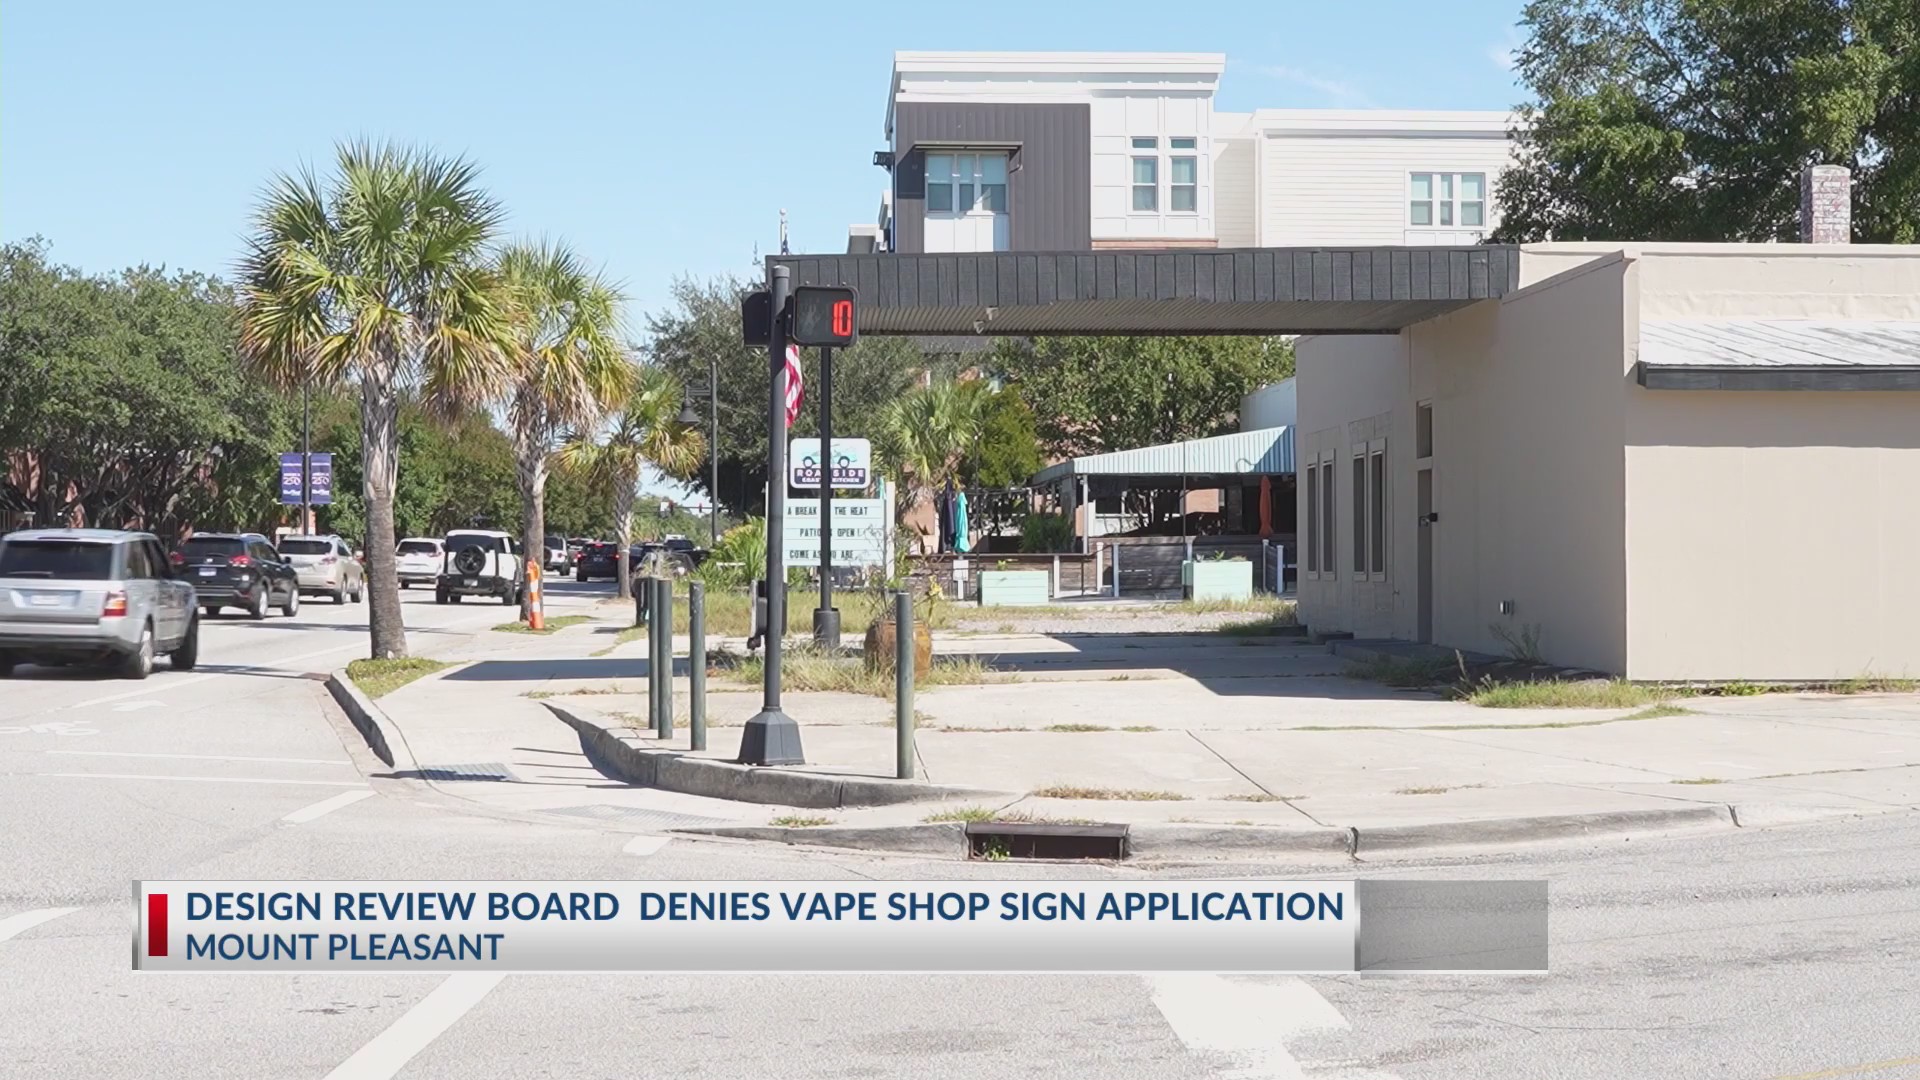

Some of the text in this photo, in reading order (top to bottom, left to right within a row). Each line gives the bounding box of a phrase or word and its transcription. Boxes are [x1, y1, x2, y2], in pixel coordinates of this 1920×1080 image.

[833, 300, 853, 337] 10
[796, 469, 864, 477] ROASIDE
[787, 506, 868, 516] A BREAK THE HEAT
[789, 550, 809, 559] COME
